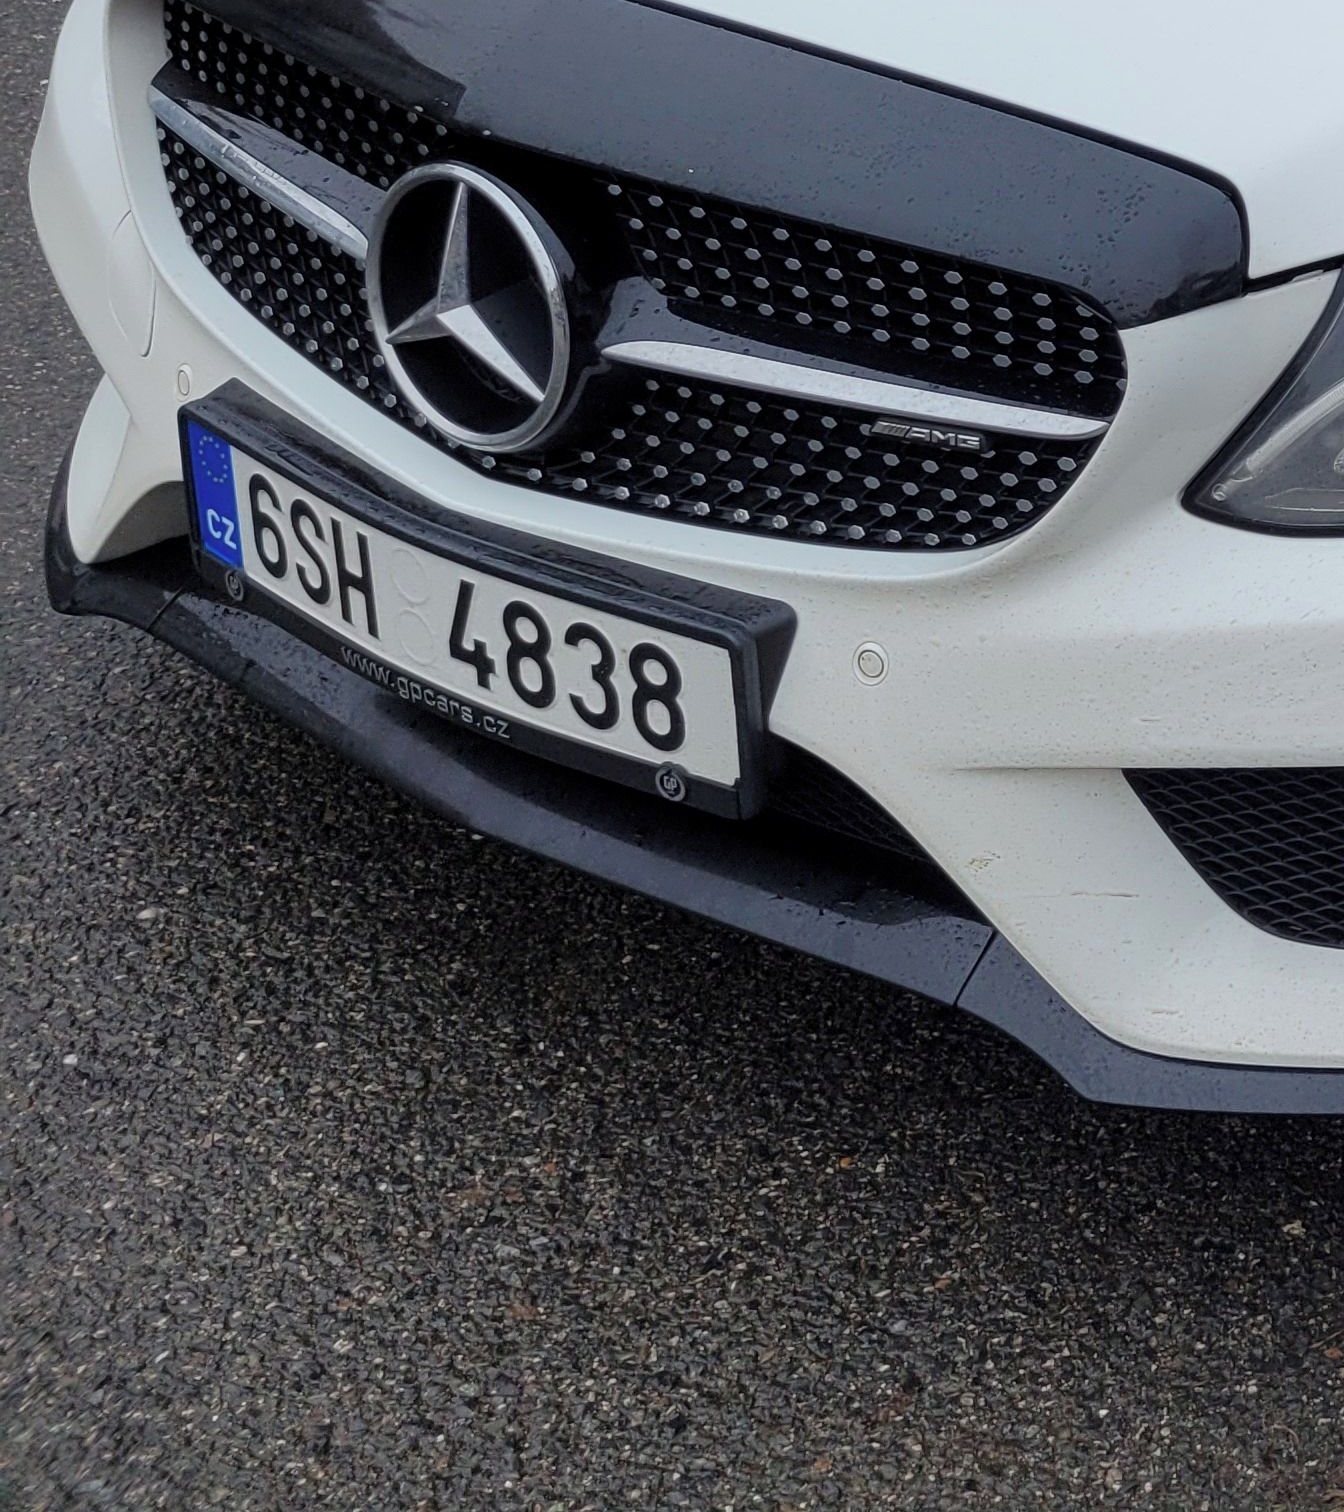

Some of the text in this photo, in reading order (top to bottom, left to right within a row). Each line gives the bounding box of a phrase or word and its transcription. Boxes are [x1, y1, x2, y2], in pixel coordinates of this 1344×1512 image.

[904, 426, 981, 450] AMG
[206, 509, 237, 550] CZ
[248, 473, 687, 753] 6SH 4838
[340, 645, 511, 739] www.gpcars.cz
